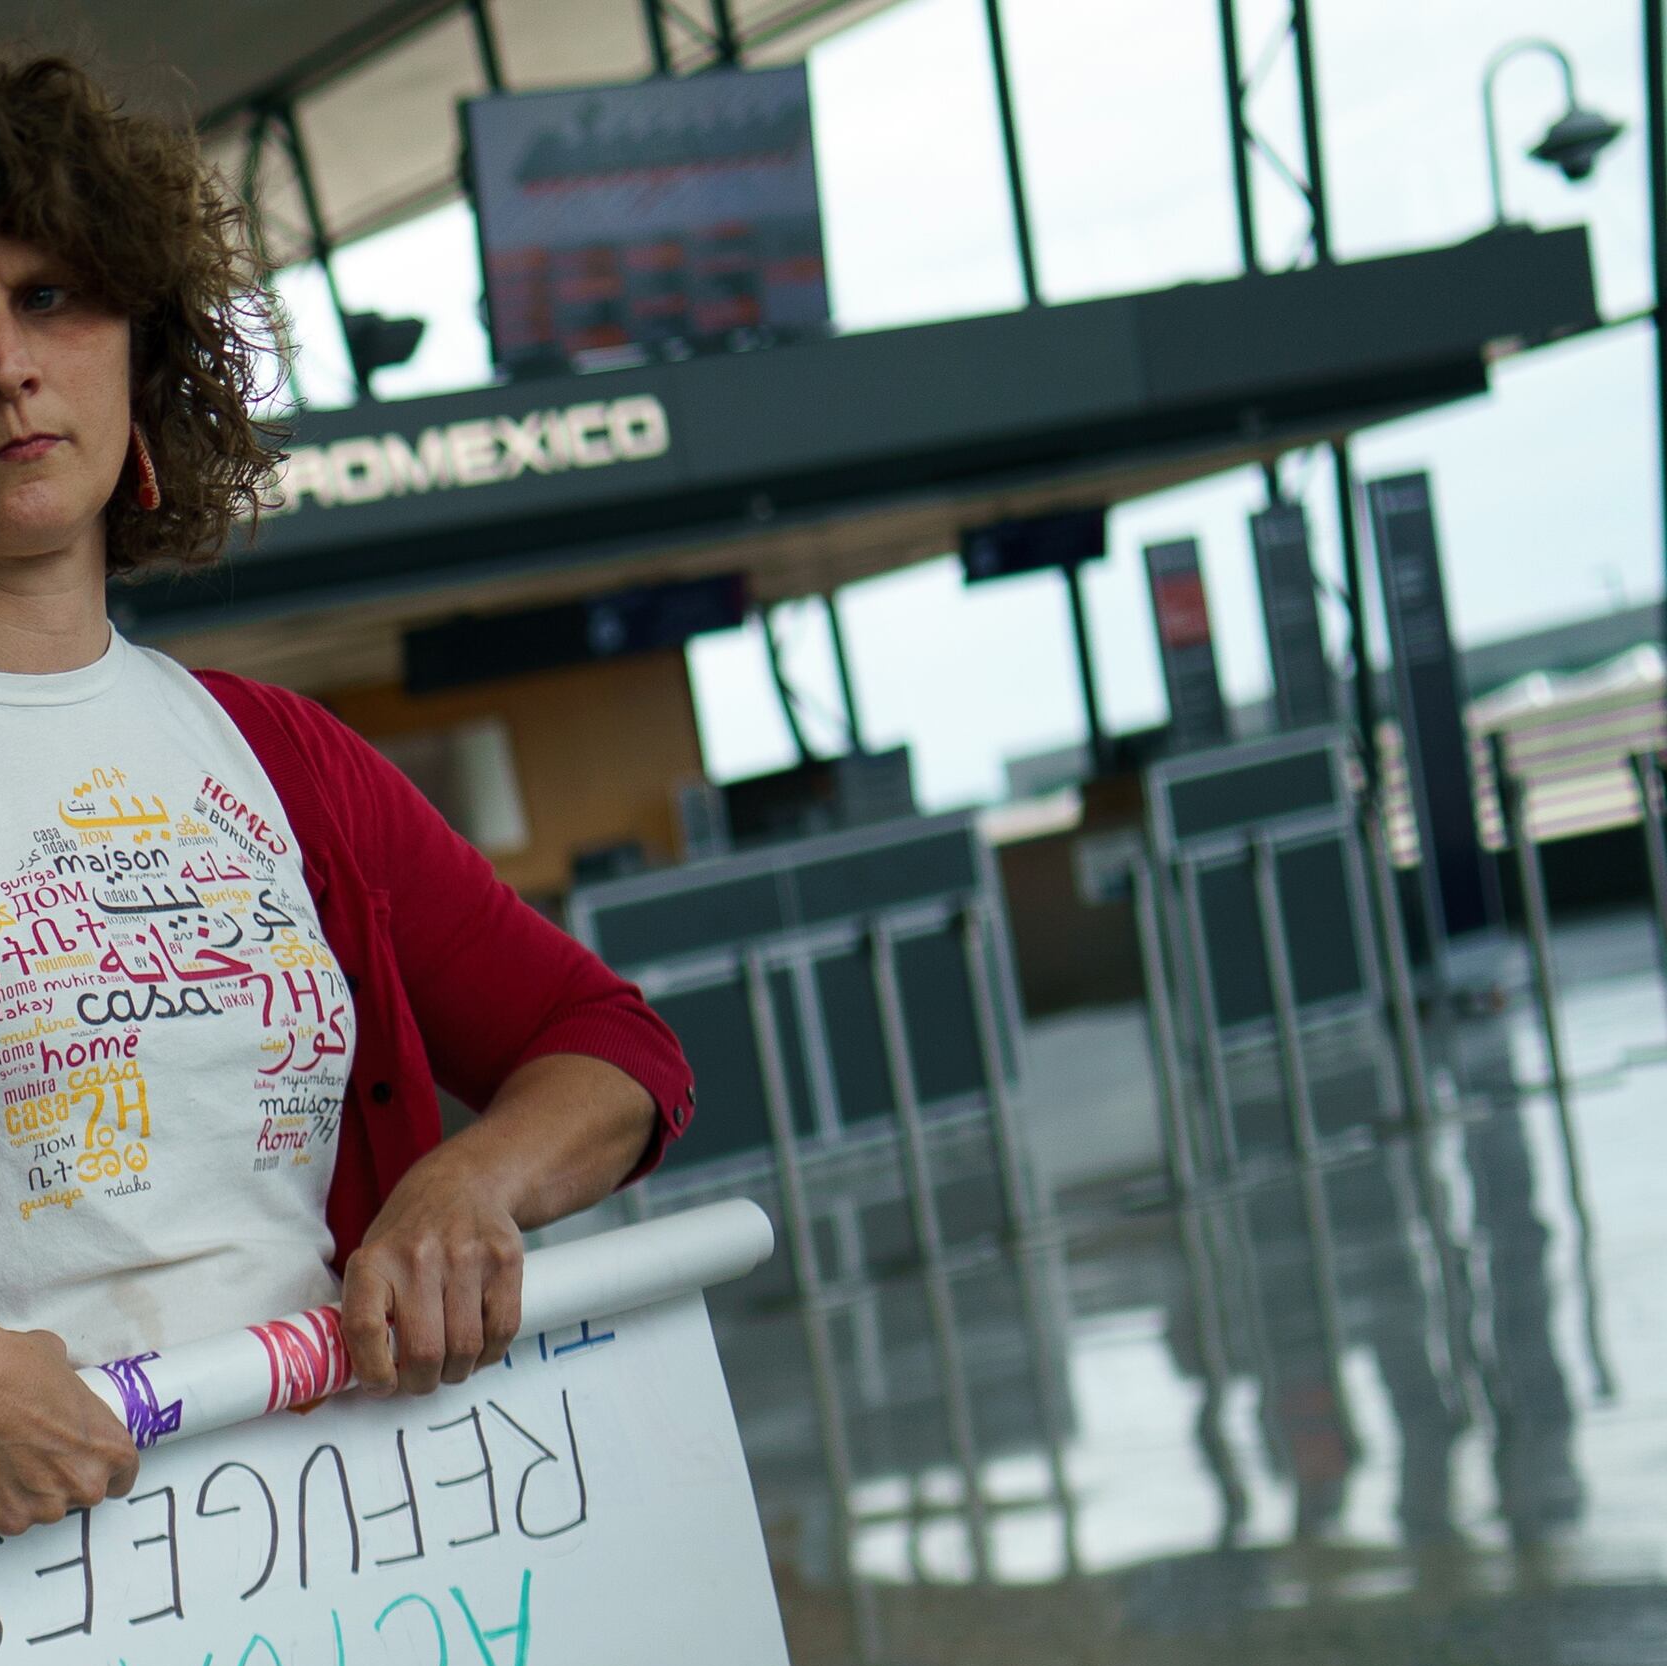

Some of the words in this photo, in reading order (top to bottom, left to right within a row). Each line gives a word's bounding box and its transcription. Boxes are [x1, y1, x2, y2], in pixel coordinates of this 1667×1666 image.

[239, 394, 669, 523] ROMEXICO
[201, 775, 288, 855] HOMES
[33, 827, 61, 843] casa
[43, 838, 78, 856] ndako
[209, 808, 276, 874] BORDERS
[53, 844, 170, 875] maison
[0, 869, 57, 896] guriga
[104, 887, 138, 903] ndako
[202, 887, 251, 908] guriga
[169, 941, 184, 955] ev
[34, 951, 96, 974] nyumbani
[134, 955, 147, 969] ev
[43, 972, 106, 992] muhira
[77, 984, 223, 1026] casa
[219, 991, 254, 1009] lakay
[0, 1015, 78, 1045] muhira
[40, 1034, 139, 1074] home
[0, 1062, 36, 1081] guriga
[68, 1060, 142, 1090] casa
[282, 1067, 346, 1093] nyumban
[4, 1078, 56, 1105] muhira
[5, 1092, 69, 1136] casa
[257, 1117, 308, 1152] home
[104, 1175, 151, 1198] ndako
[19, 1187, 84, 1220] guriga
